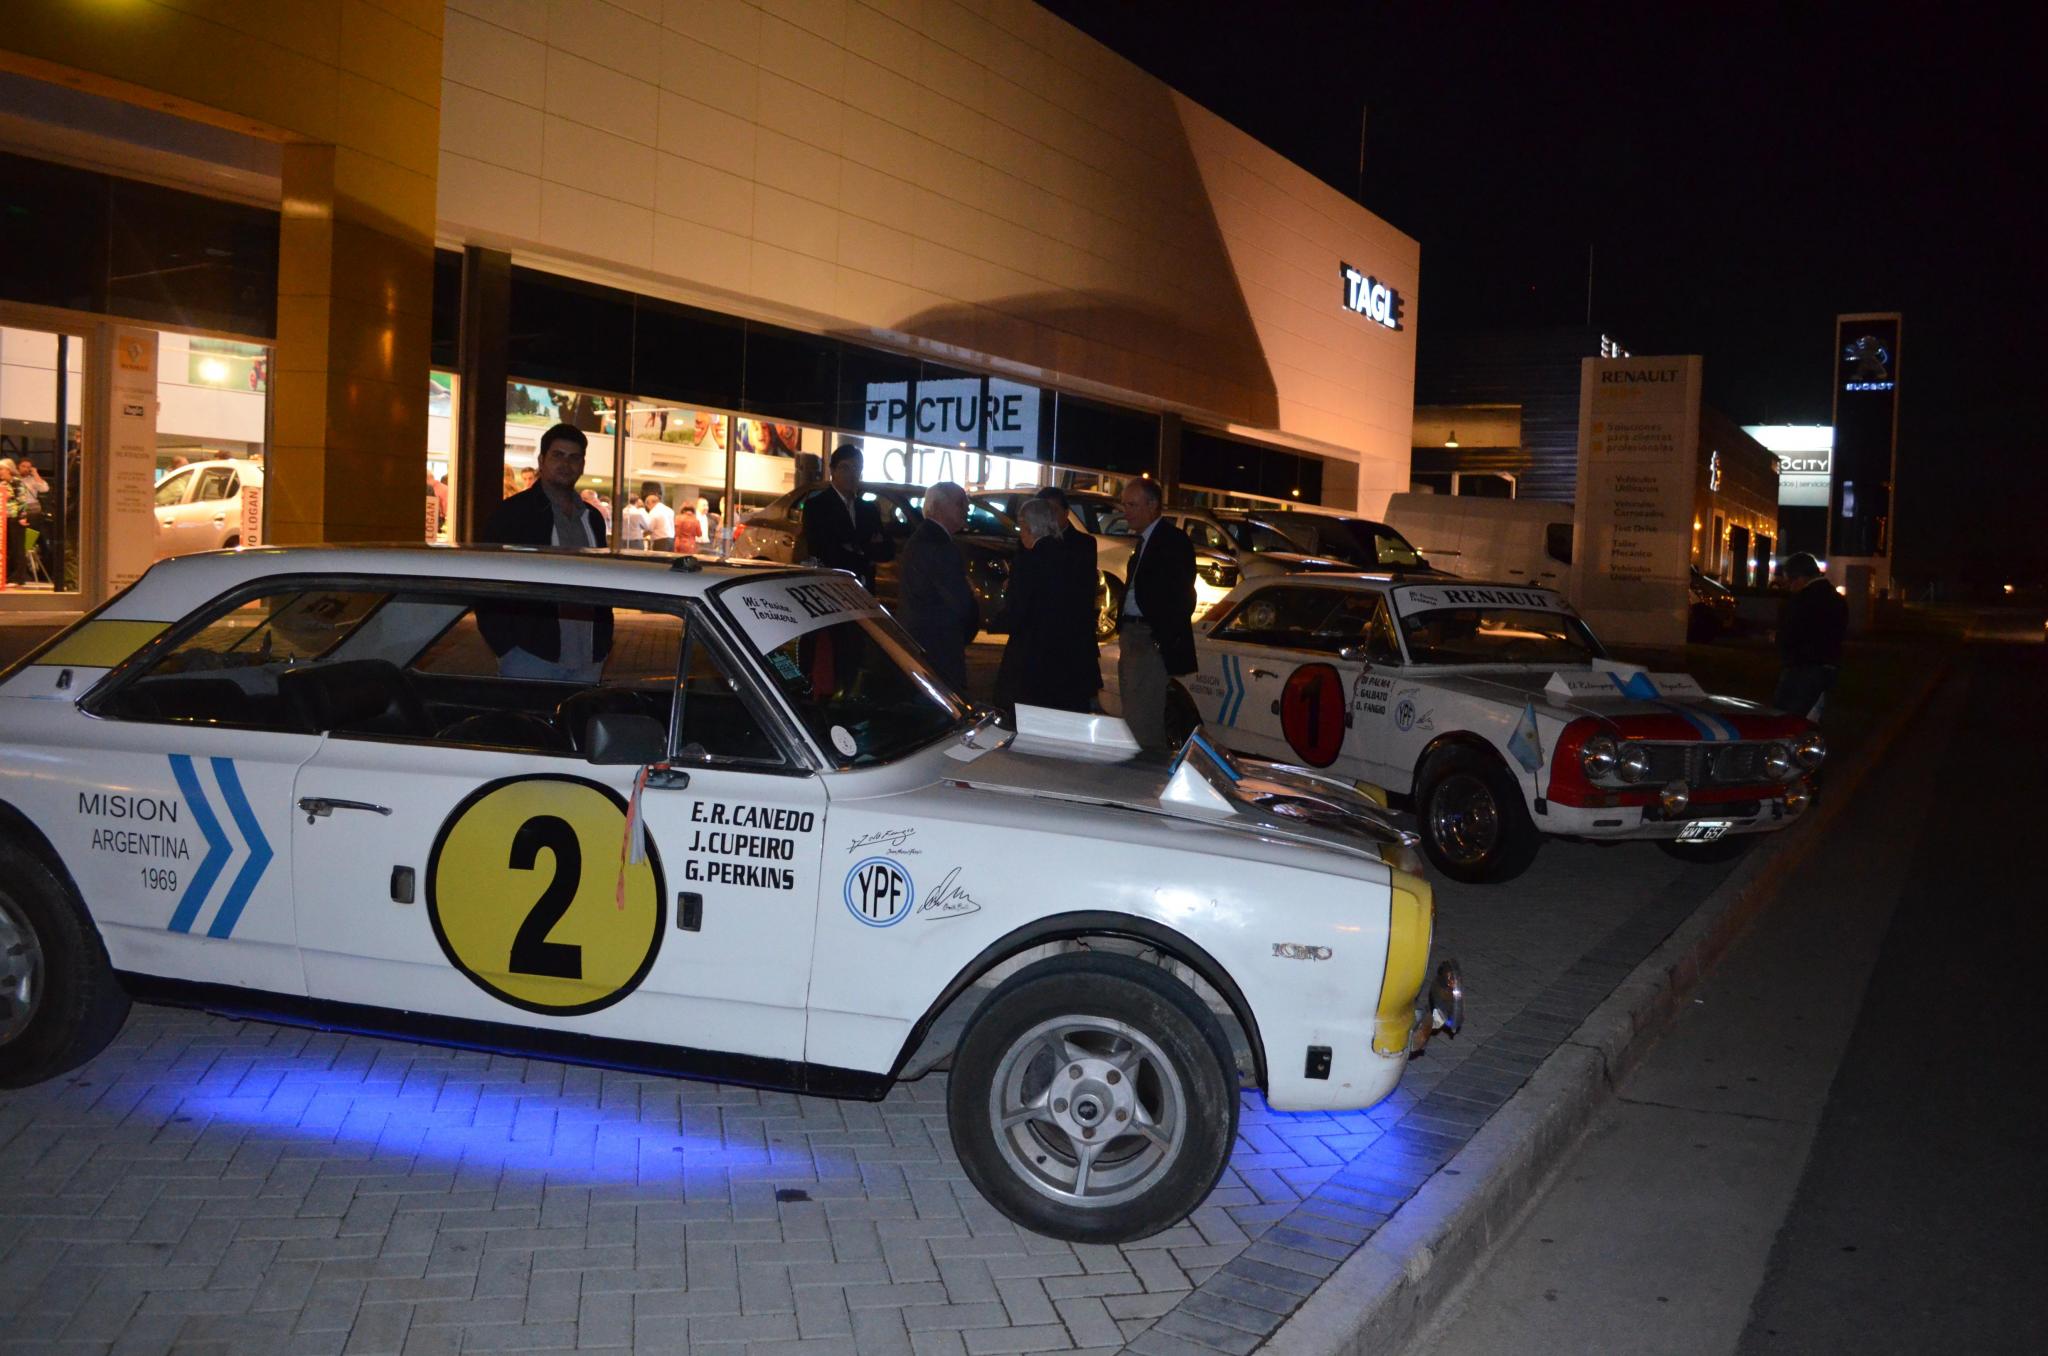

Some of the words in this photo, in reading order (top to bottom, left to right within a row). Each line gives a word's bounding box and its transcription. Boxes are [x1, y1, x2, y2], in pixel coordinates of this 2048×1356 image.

[1601, 369, 1680, 384] RENAULT
[888, 394, 1023, 433] PCTURE
[248, 490, 259, 534] LOGAN
[426, 501, 436, 539] LOGAN
[1443, 589, 1550, 608] RENAULT
[1300, 674, 1323, 748] 1
[1399, 703, 1414, 726] YPF
[79, 792, 177, 823] MISION
[92, 828, 190, 861] ARGENTINA
[141, 866, 178, 892] 1969
[858, 864, 904, 918] YPF
[508, 814, 583, 980] 2
